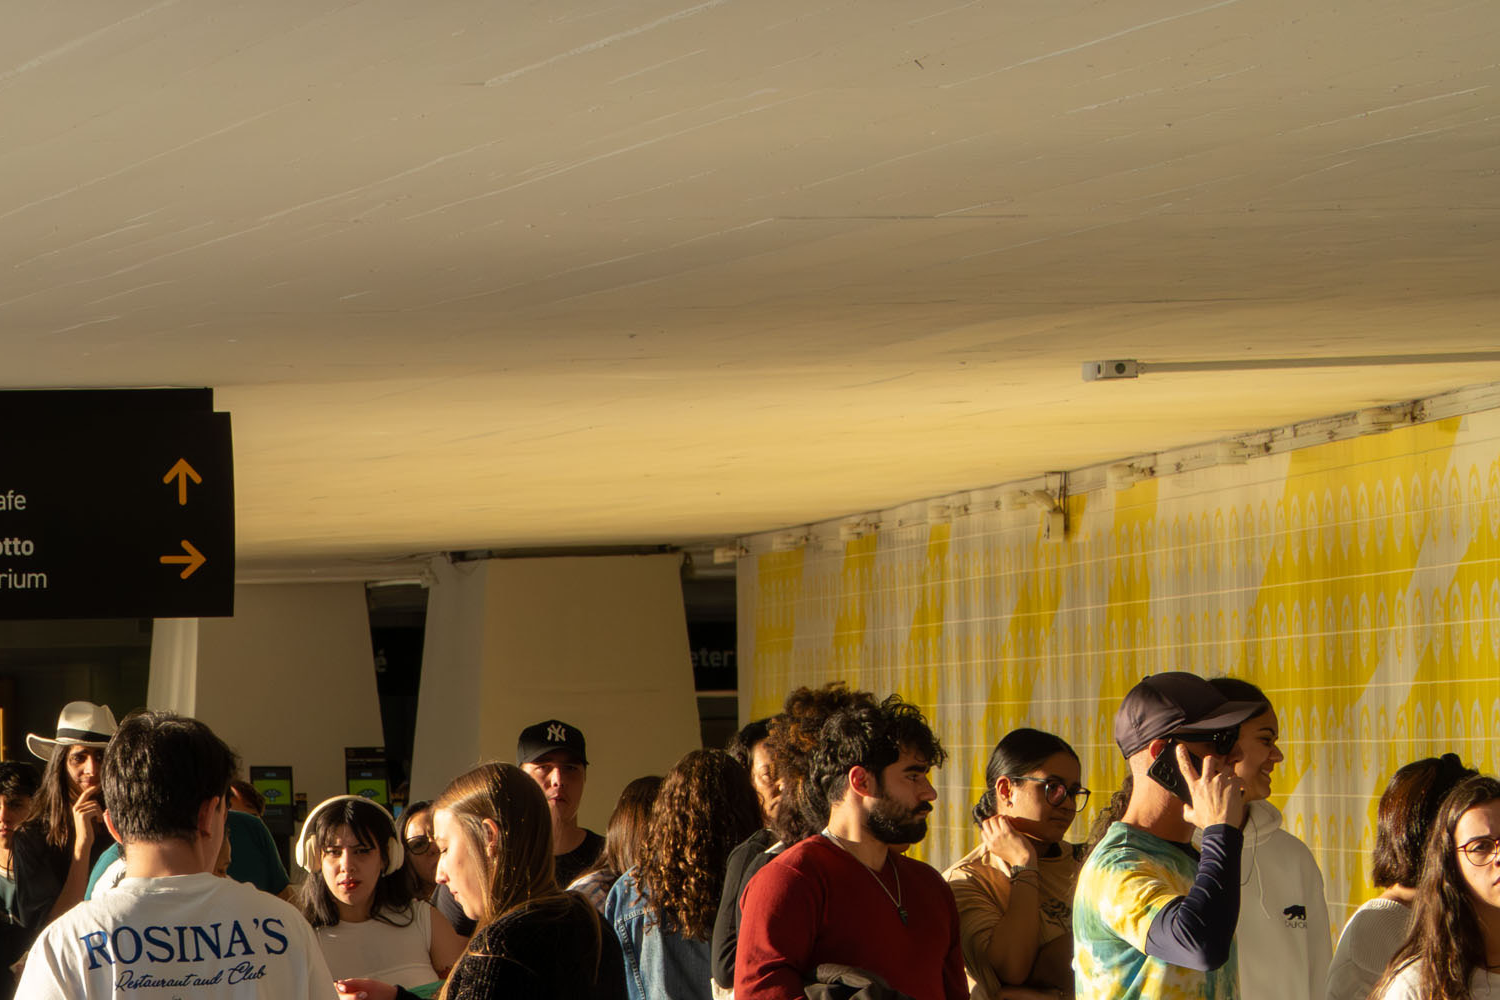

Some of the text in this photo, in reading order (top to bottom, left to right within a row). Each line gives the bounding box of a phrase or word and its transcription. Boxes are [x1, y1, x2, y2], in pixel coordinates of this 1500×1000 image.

[79, 918, 289, 970] ROSINA'S
[115, 961, 267, 992] Restaurant and Club
